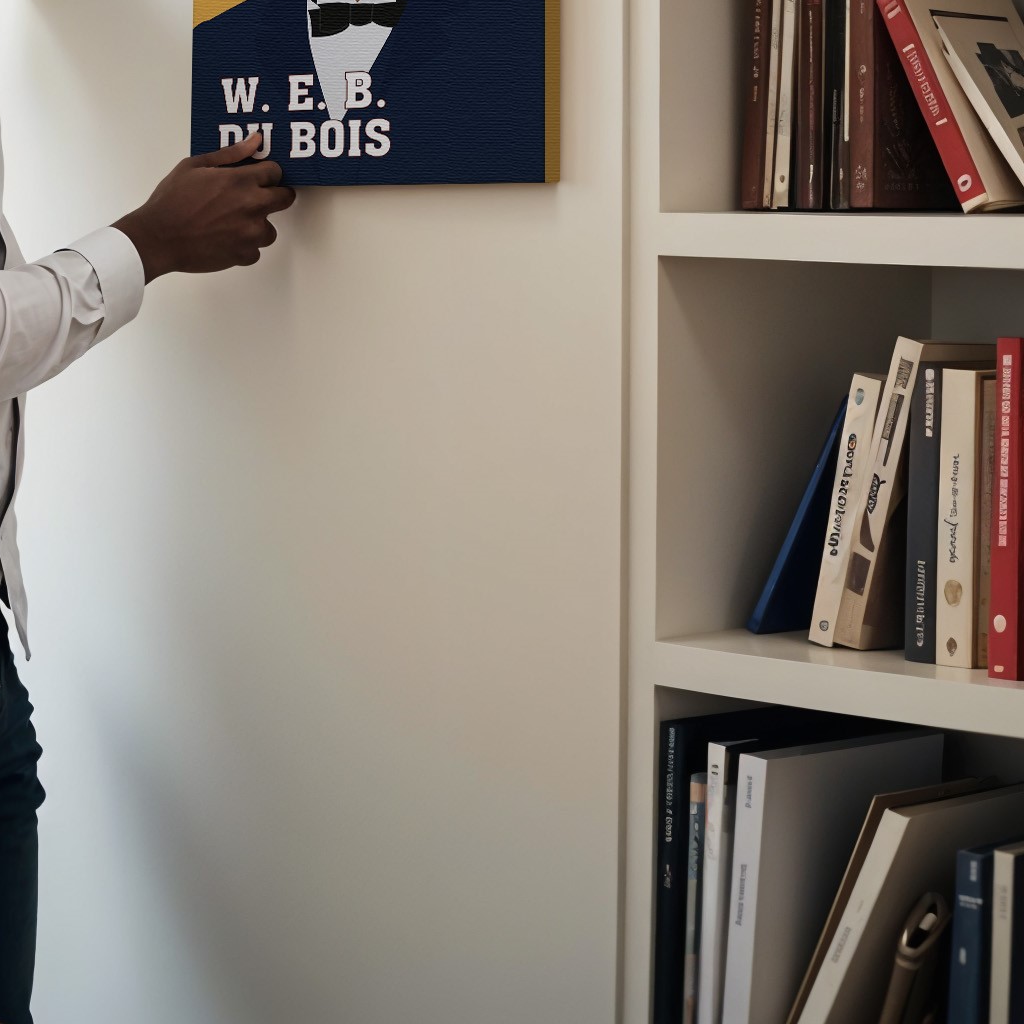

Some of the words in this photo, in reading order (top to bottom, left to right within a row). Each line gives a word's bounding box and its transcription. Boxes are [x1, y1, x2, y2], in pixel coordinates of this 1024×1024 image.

[221, 76, 270, 114] W.
[288, 73, 327, 112] E.
[344, 70, 386, 110] B.
[289, 118, 391, 159] BOIS
